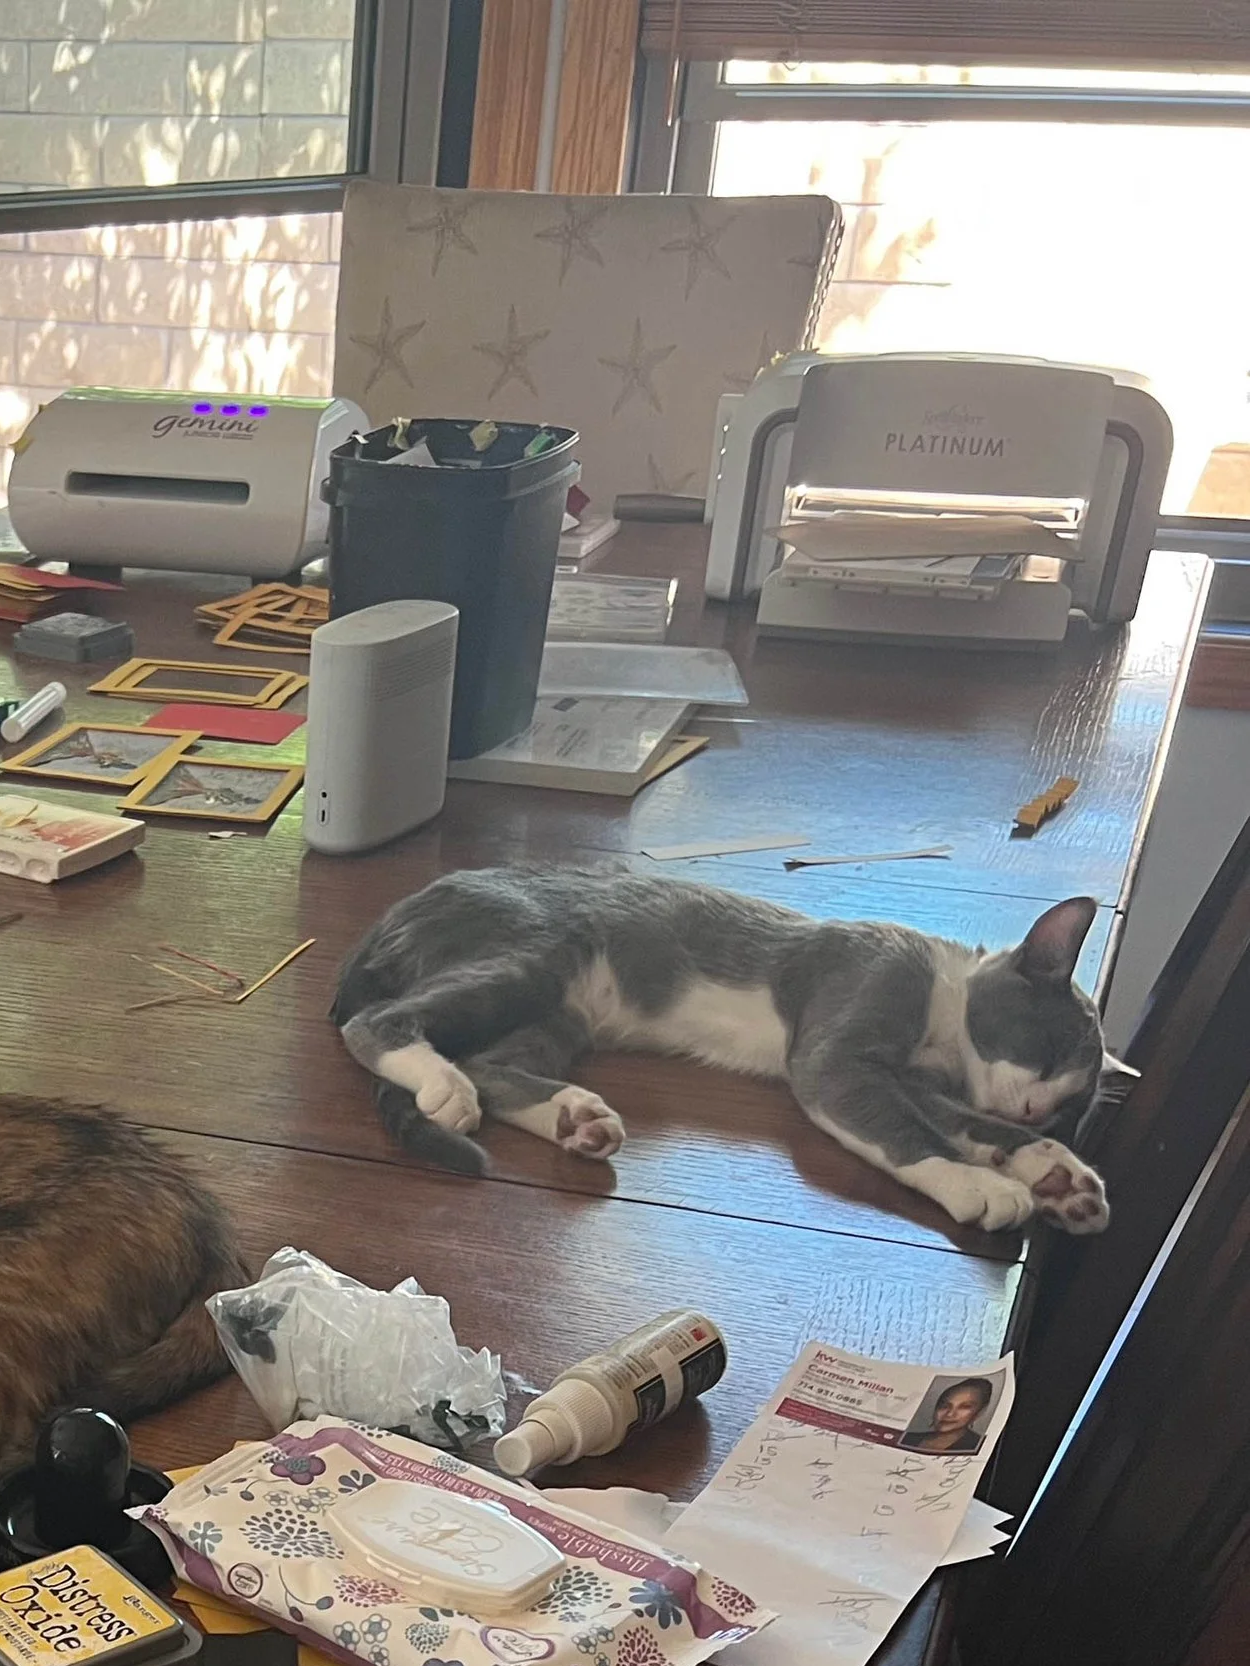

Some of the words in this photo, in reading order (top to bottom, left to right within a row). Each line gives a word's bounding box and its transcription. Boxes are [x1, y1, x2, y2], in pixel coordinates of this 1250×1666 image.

[152, 415, 259, 438] gemini
[884, 433, 1004, 456] PLATINUM
[808, 1363, 855, 1385] Carmen
[557, 1531, 650, 1573] flushable
[0, 1585, 82, 1653] Oxide
[33, 1564, 137, 1643] Distress
